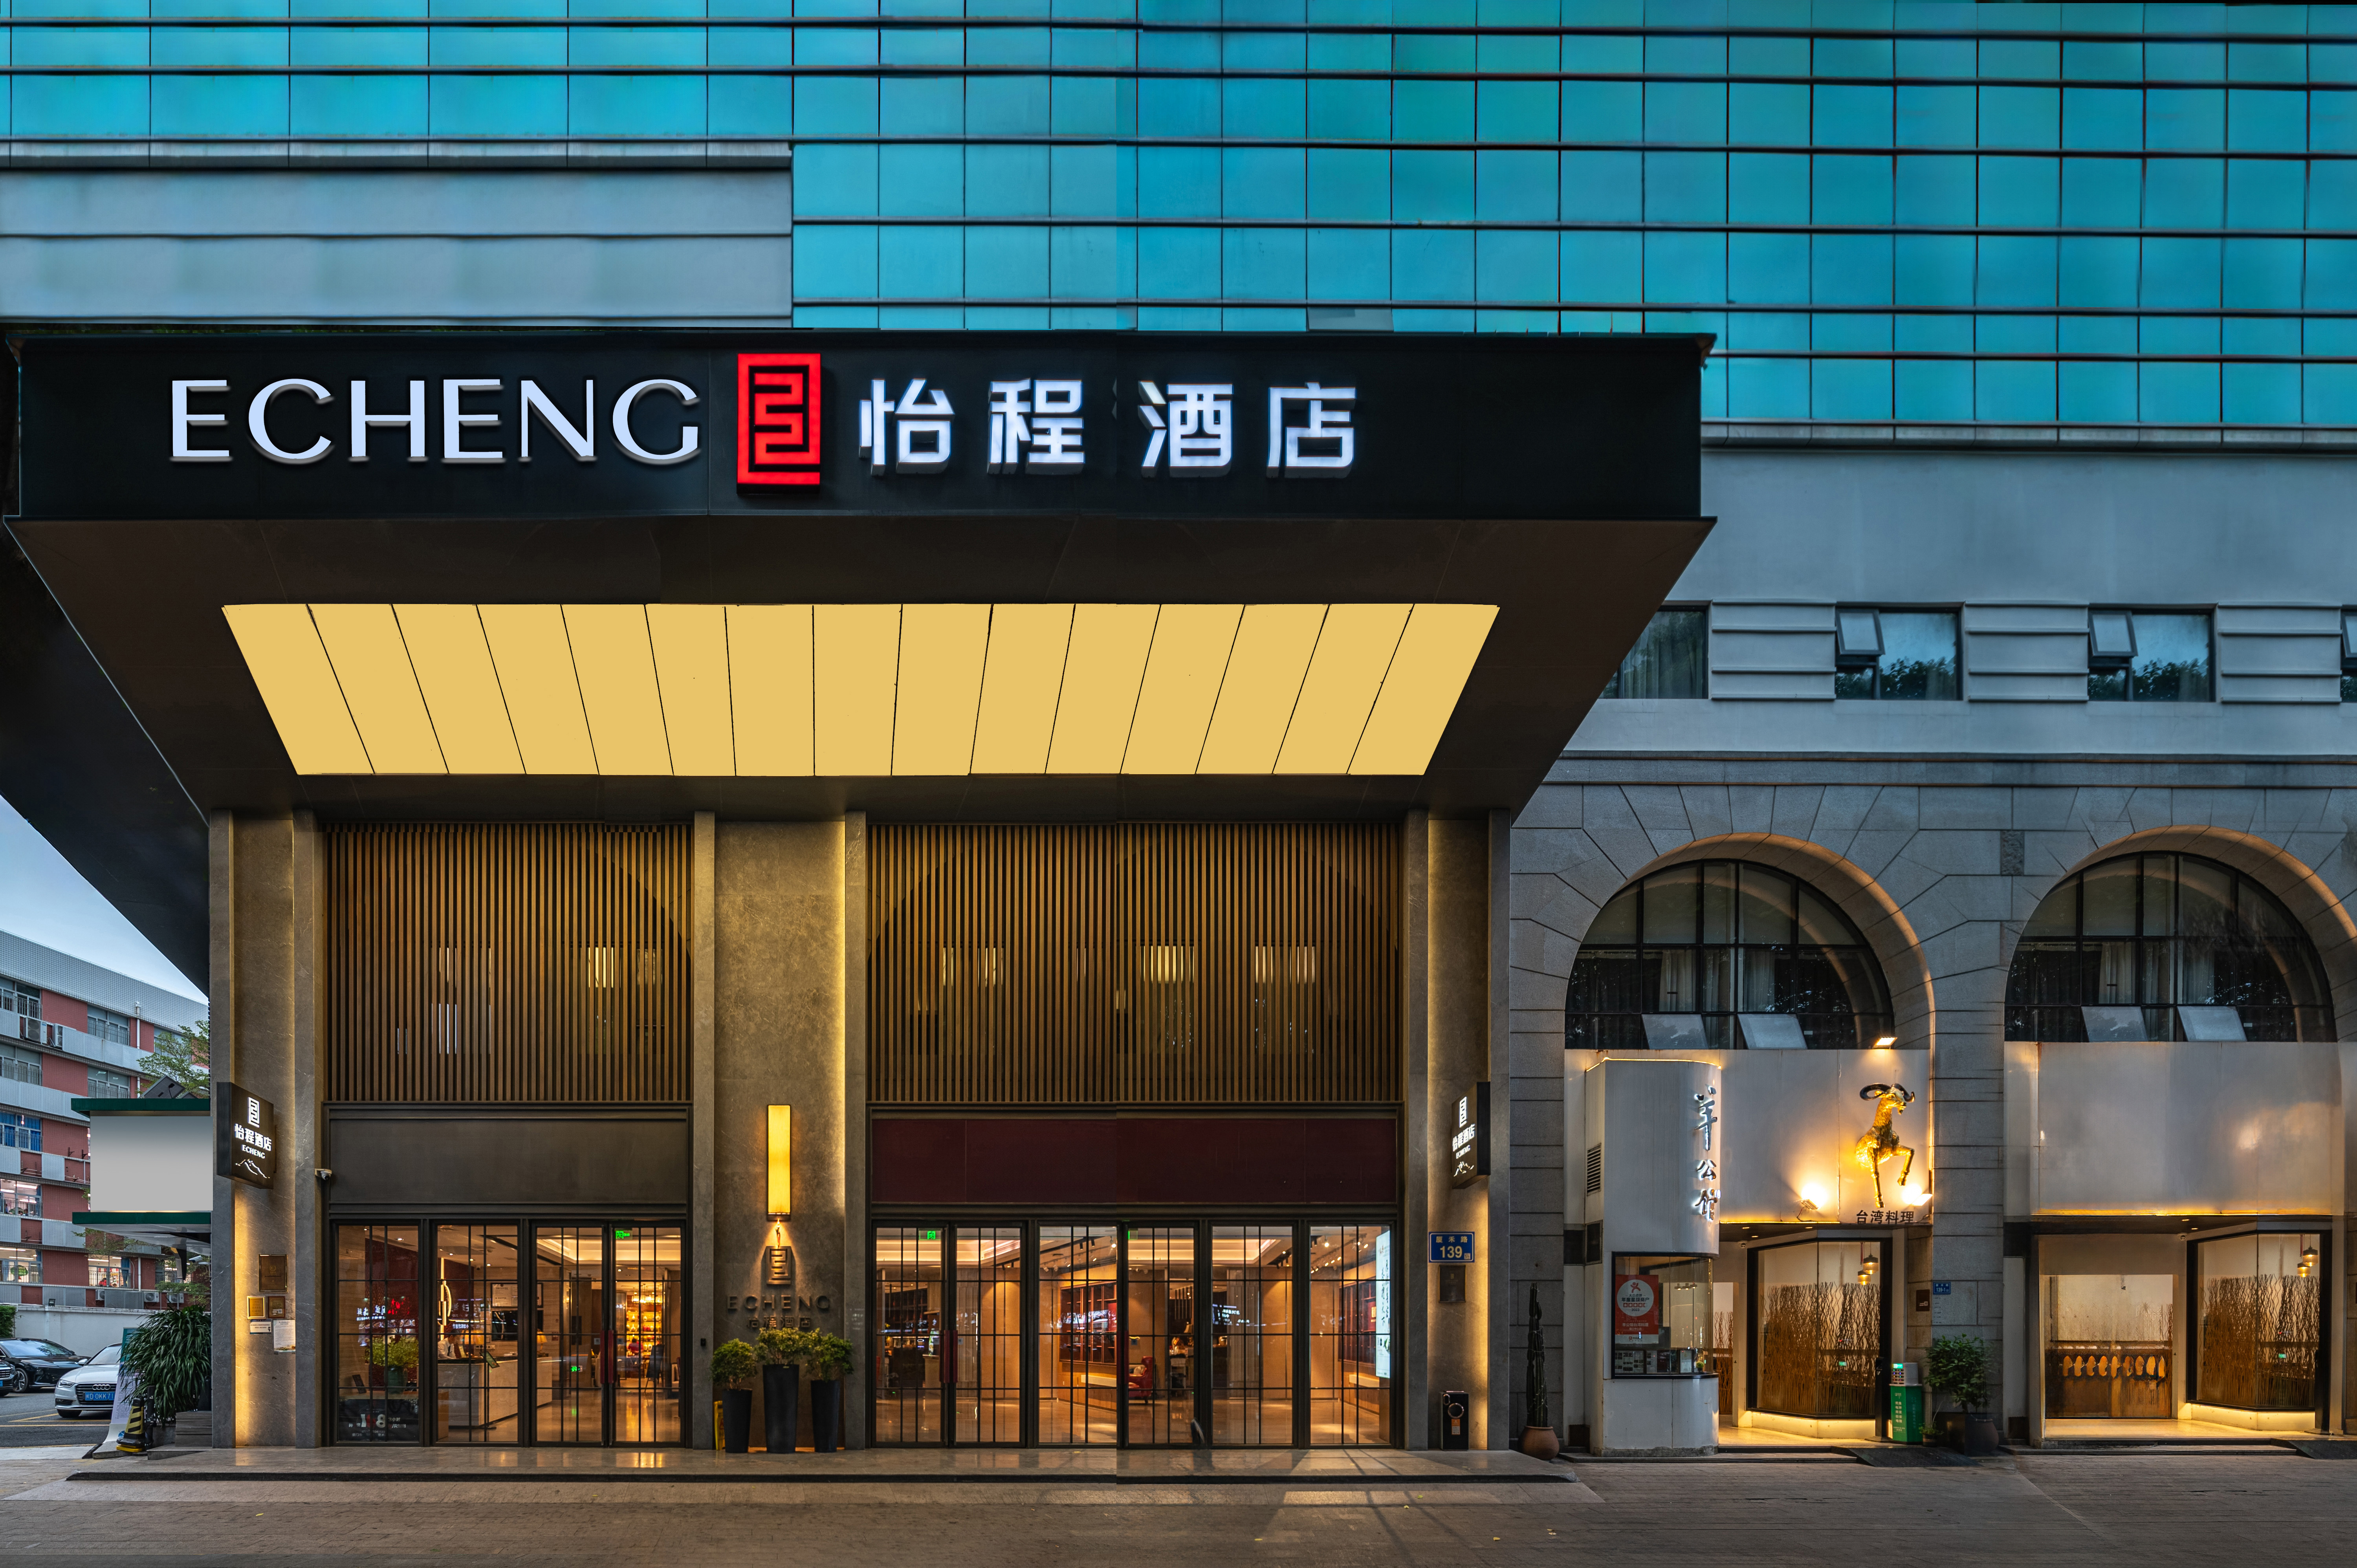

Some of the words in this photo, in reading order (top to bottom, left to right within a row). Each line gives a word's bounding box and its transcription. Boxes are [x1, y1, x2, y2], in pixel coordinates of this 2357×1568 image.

[171, 378, 700, 463] ECHENG
[859, 378, 1356, 476] 怡程酒店
[235, 1123, 272, 1152] 怡程酒店
[242, 1144, 265, 1159] ECHENG
[1456, 1145, 1471, 1159] ECHENG
[1857, 1210, 1914, 1224] 台湾料理
[1440, 1246, 1463, 1258] 139
[728, 1295, 830, 1310] ECHENG
